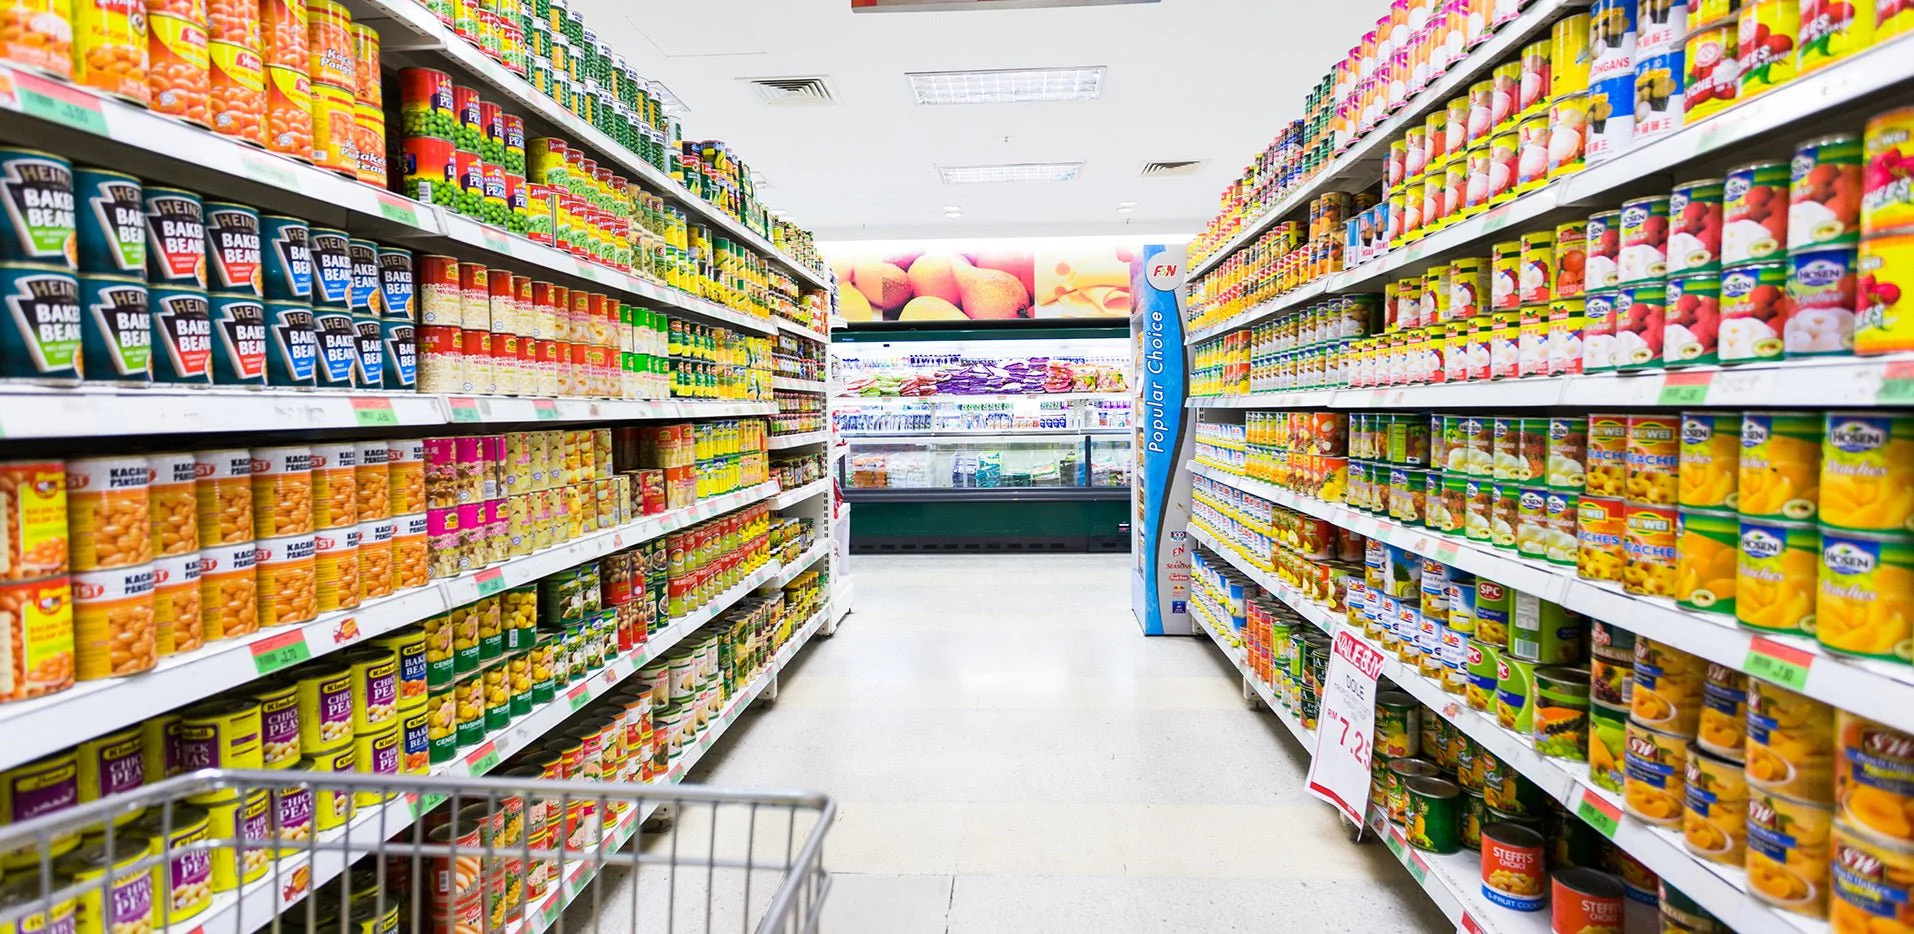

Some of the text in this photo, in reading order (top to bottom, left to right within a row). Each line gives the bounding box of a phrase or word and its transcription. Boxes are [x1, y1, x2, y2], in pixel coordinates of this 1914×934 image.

[1154, 265, 1177, 277] F&N
[1800, 269, 1840, 281] HOSEN
[1147, 311, 1169, 453] Popular Choice
[1833, 430, 1880, 444] HOSEN
[1742, 537, 1778, 552] HOSEN
[1825, 551, 1869, 568] HOSEN
[1480, 584, 1500, 596] SPC
[1346, 674, 1365, 700] DOLE
[1493, 846, 1533, 863] STEFFI'S
[1500, 859, 1526, 870] CHOICE
